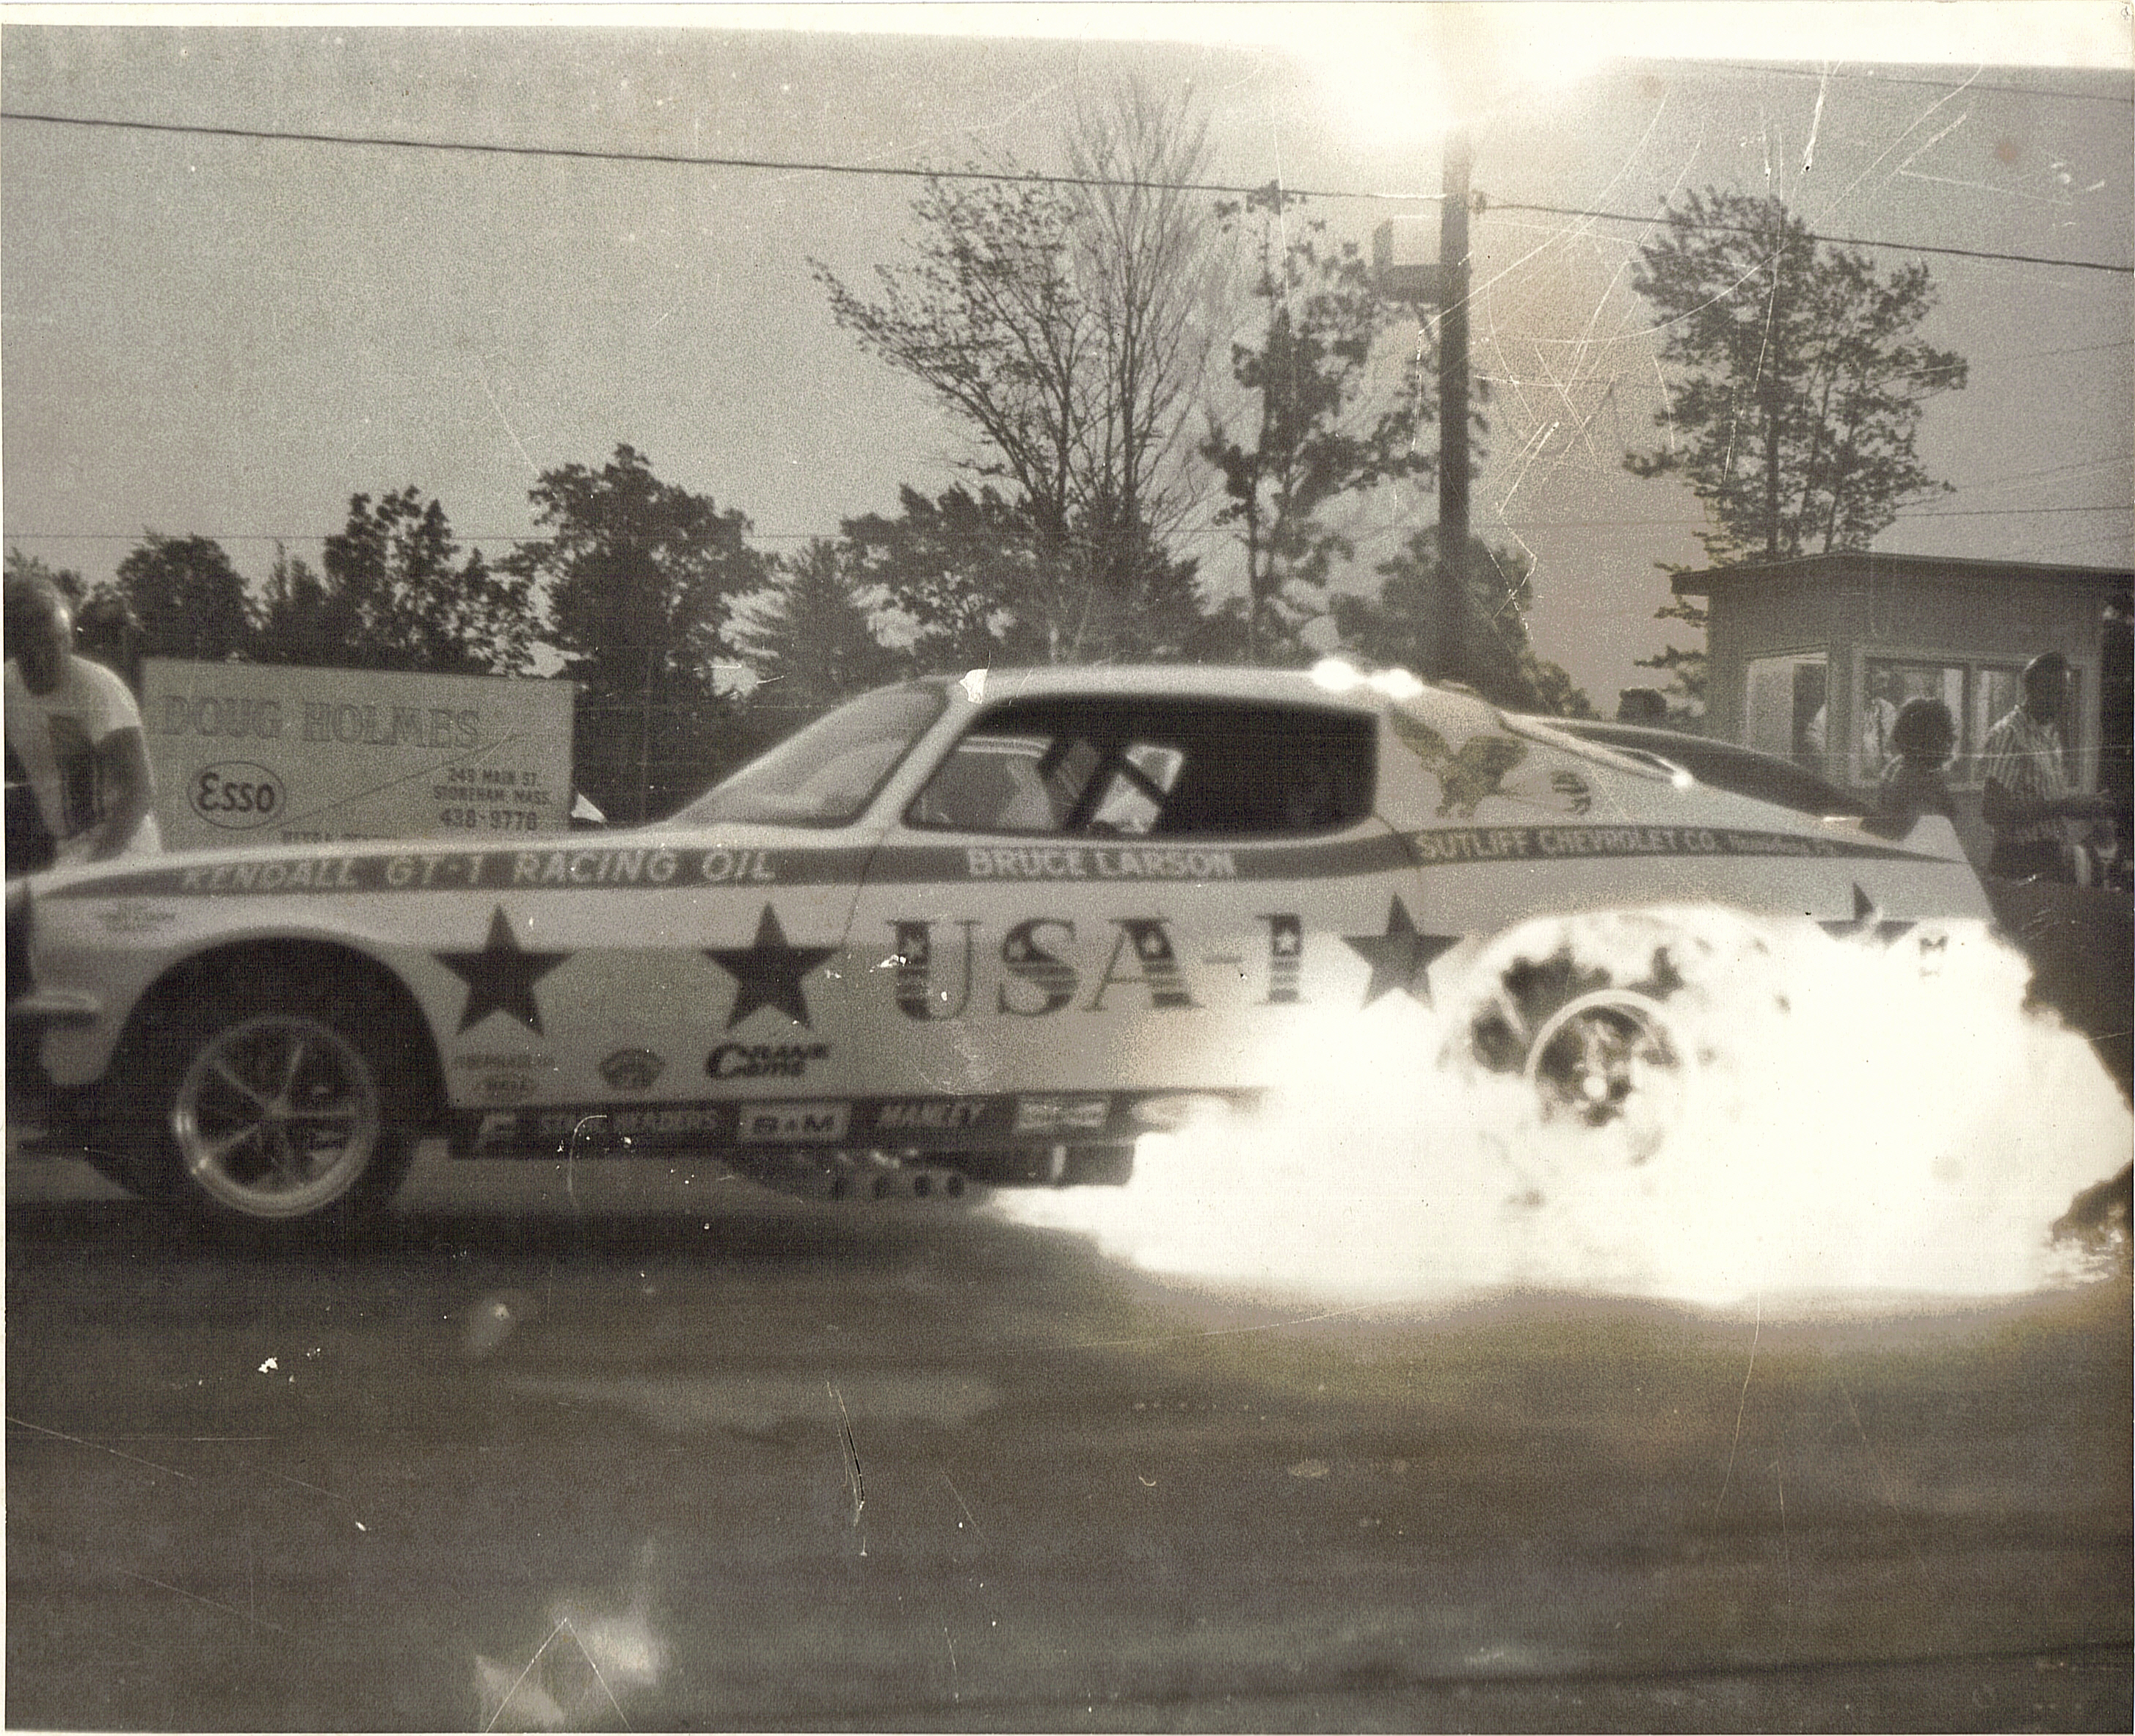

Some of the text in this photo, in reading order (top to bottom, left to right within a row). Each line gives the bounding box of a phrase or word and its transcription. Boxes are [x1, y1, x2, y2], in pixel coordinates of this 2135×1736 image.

[159, 695, 481, 749] DOUG HOLMES
[482, 769, 516, 785] MAIN
[1414, 829, 1529, 860] SUTLIFF
[1537, 828, 1678, 856] CHEVROLET
[181, 849, 776, 890] KENDALL GT-1 RACING OIL
[967, 848, 1237, 876] BRUCE LARSON
